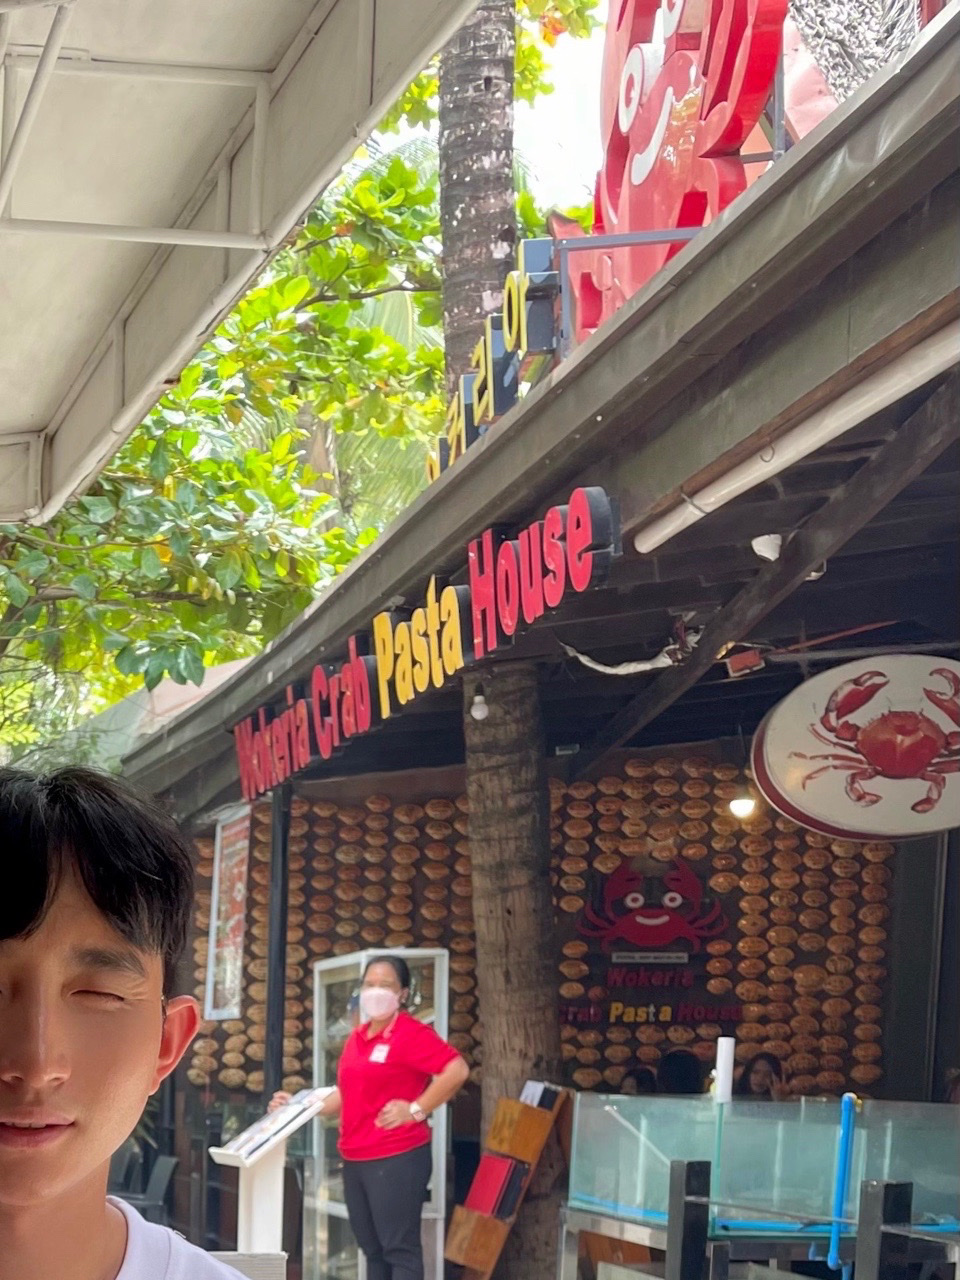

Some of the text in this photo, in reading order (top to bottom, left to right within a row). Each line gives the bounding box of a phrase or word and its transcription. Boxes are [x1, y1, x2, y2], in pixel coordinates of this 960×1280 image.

[312, 635, 371, 760] Crab
[373, 574, 464, 719] Pasta
[468, 487, 593, 660] House
[607, 967, 693, 987] Wokeria
[609, 1001, 673, 1023] Pasta
